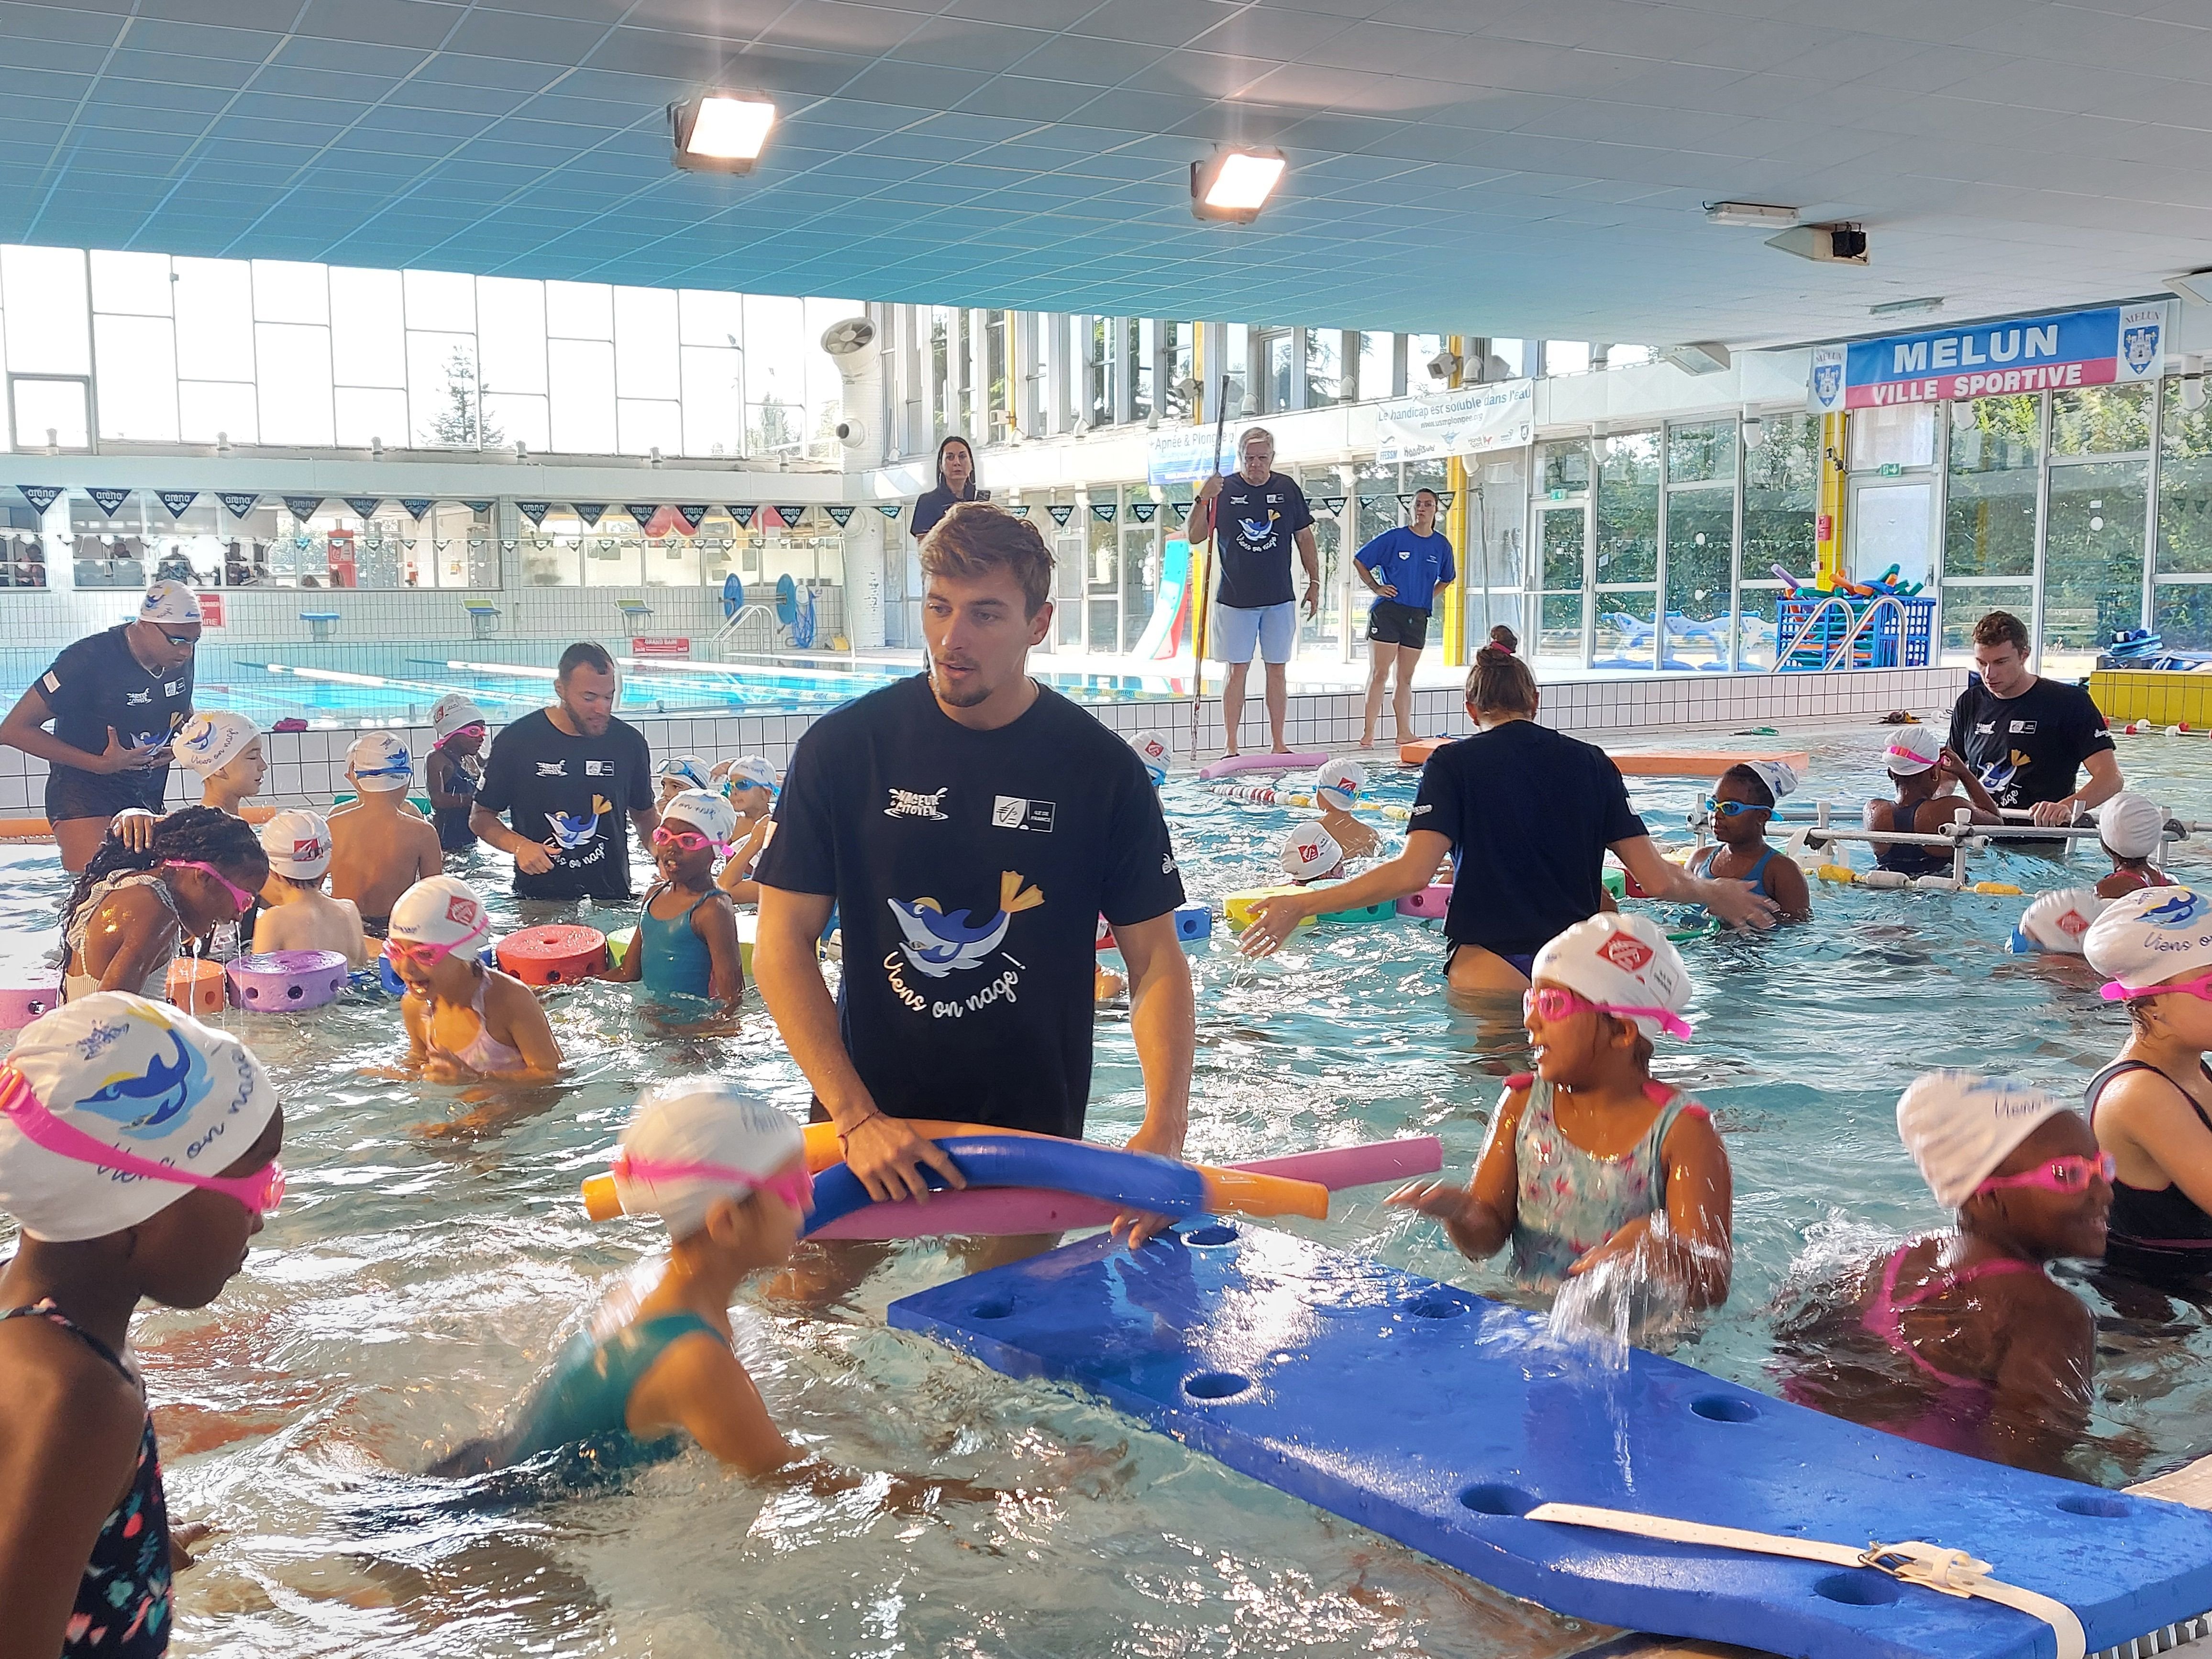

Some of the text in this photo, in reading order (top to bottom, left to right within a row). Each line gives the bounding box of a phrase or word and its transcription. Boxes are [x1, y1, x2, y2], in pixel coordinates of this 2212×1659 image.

[1893, 324, 2058, 374] MELUN
[1873, 364, 2082, 405] VILLE SPORTIVE
[1379, 387, 1531, 421] Le handicap est soluble dans l'eau
[1155, 435, 1182, 453] Apnée
[1184, 434, 1190, 446] &
[28, 488, 56, 498] arena
[96, 490, 122, 500] arena
[164, 491, 190, 502] arena
[225, 494, 251, 504] arena
[292, 498, 317, 508] arena
[405, 498, 429, 508] arena
[522, 504, 545, 512] arena
[631, 505, 653, 514] arena
[682, 507, 704, 515] arena
[731, 507, 752, 516] arena
[780, 507, 800, 516] arena
[830, 508, 852, 516] arena
[214, 748, 224, 760] on
[895, 801, 937, 816] CITOYEN
[569, 858, 582, 868] on
[2144, 931, 2192, 951] Viens
[884, 951, 927, 1011] Viens
[932, 1001, 963, 1018] on
[965, 971, 1019, 1011] nage
[187, 1122, 224, 1159] on
